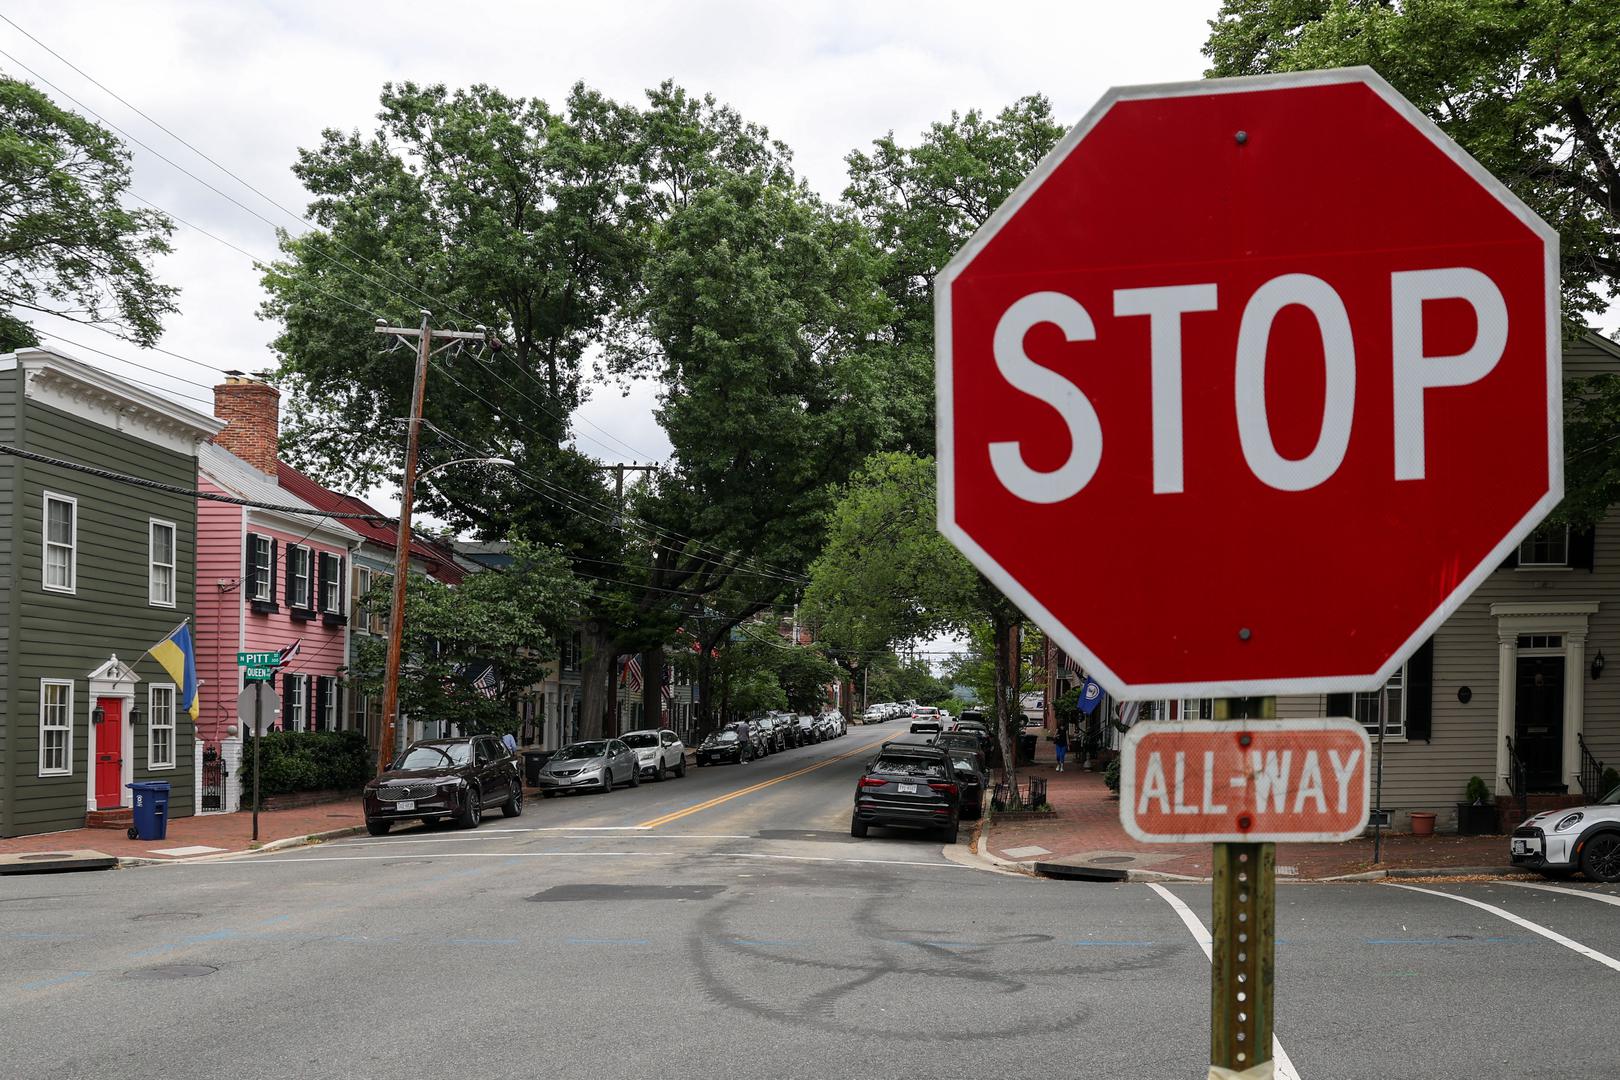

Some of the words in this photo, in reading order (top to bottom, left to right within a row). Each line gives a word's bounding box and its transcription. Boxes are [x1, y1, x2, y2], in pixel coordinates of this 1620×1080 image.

[988, 267, 1509, 504] STOP
[246, 654, 269, 663] PITT
[247, 668, 266, 677] QUEEN
[1137, 749, 1362, 815] ALL-WAY
